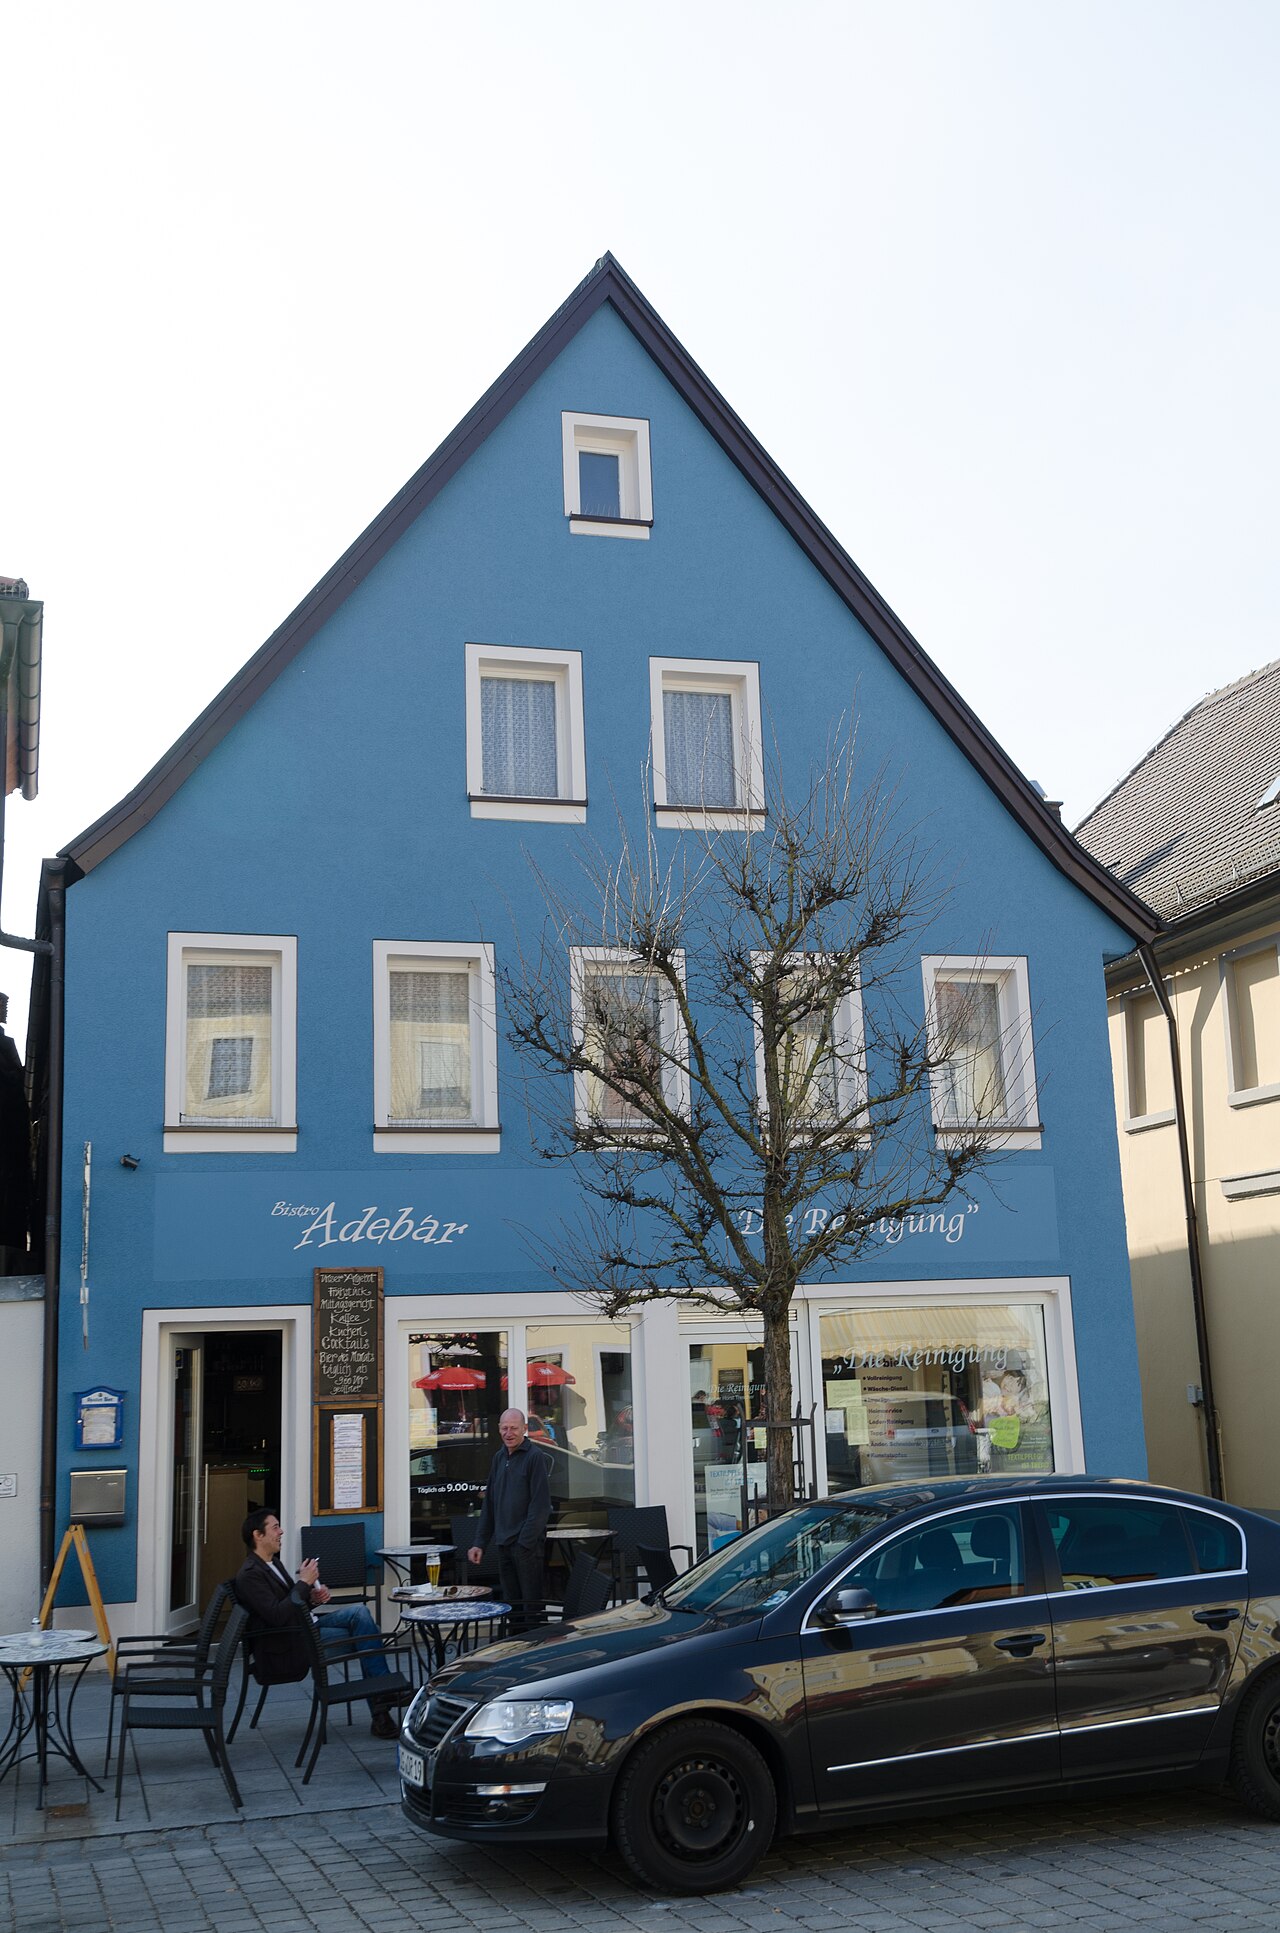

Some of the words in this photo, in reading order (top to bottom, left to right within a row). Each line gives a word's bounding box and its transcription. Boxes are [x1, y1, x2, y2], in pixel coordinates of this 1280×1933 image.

[270, 1200, 320, 1217] Bistro
[320, 1298, 376, 1313] Mittagsgericht
[330, 1312, 370, 1326] Kaffee
[329, 1325, 368, 1340] Kuchen
[321, 1335, 370, 1350] Cocktails
[319, 1351, 338, 1364] Bier
[893, 1342, 1010, 1374] Reinigung
[322, 1363, 352, 1379] täglich
[355, 1364, 368, 1374] ab
[446, 1483, 469, 1492] 9.00
